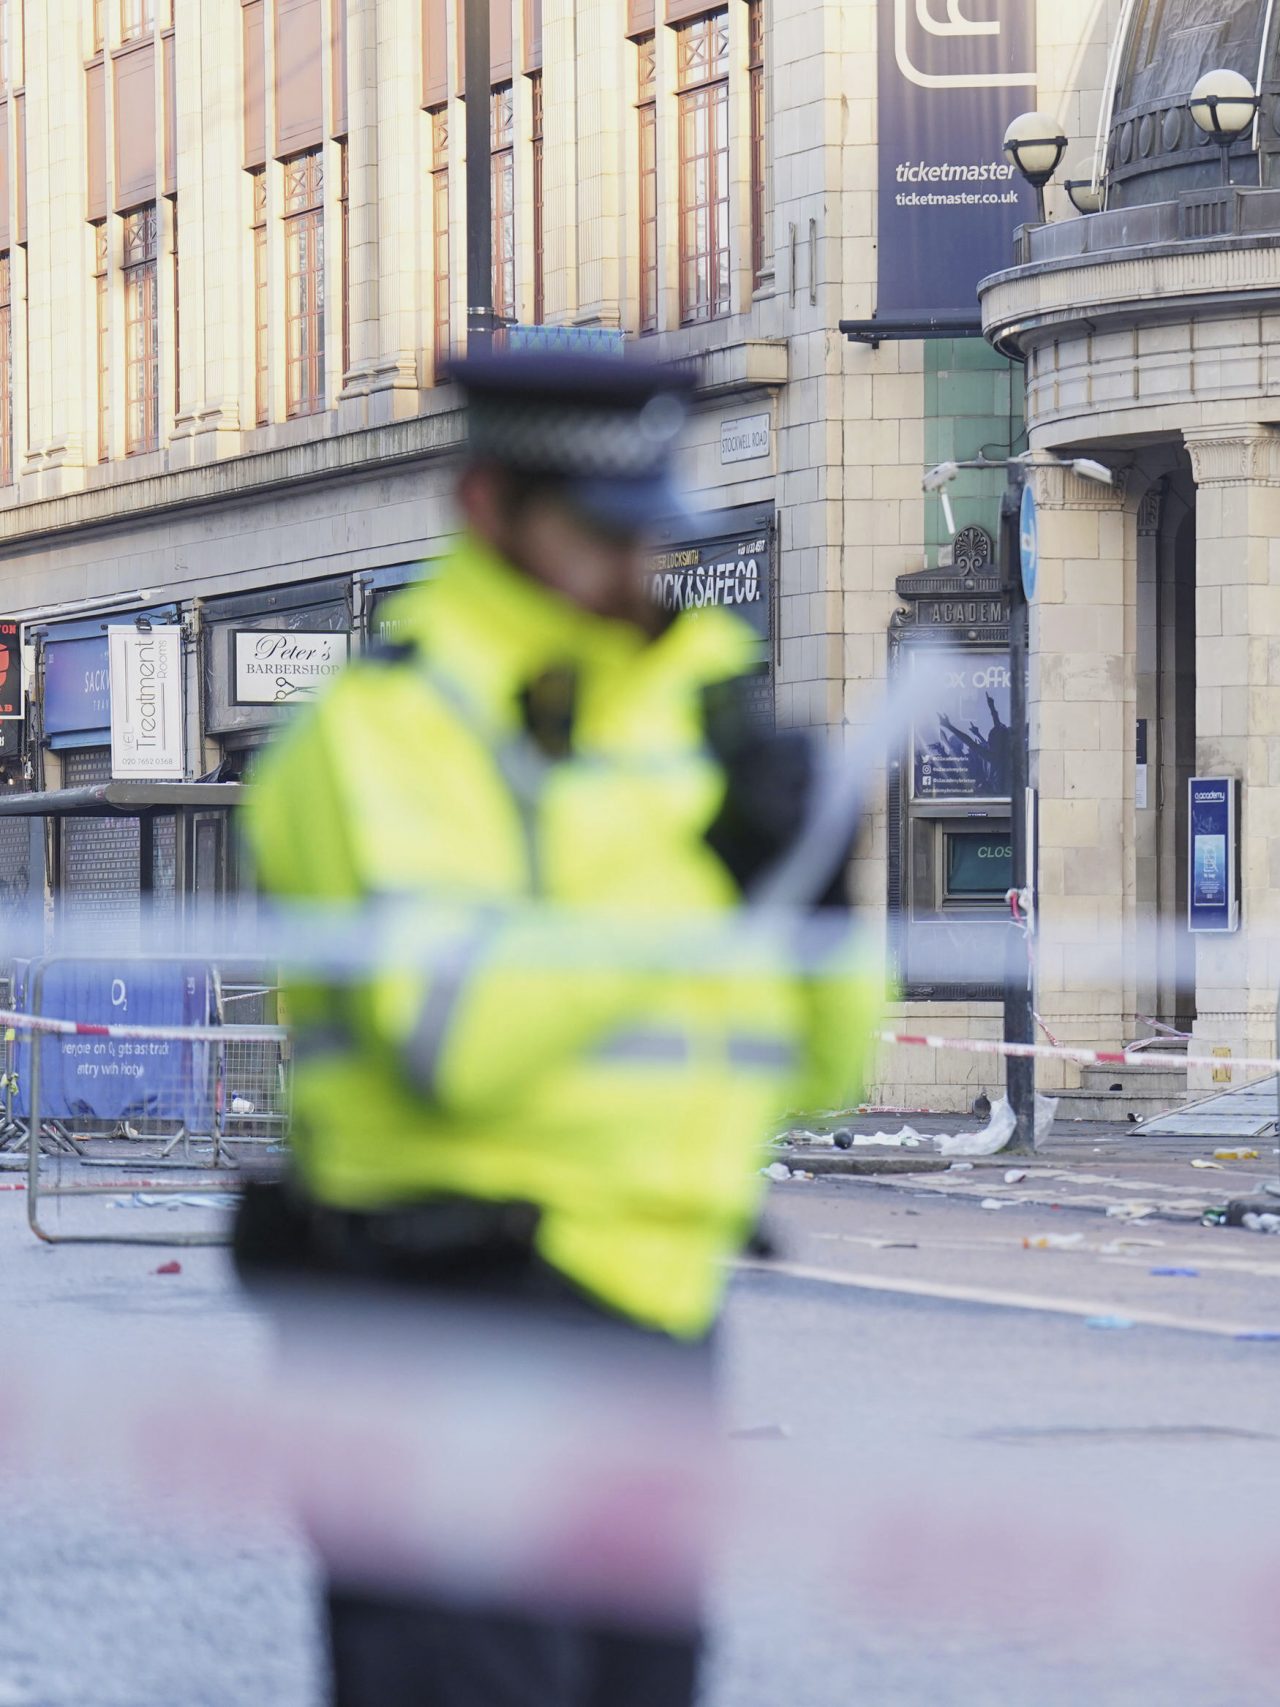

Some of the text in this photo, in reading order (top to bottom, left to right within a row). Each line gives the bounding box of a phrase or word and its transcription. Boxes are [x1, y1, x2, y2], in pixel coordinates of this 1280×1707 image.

[896, 161, 1016, 183] ticketmaster
[895, 190, 1019, 206] ticketmaster.co.uk
[721, 430, 768, 454] STOCKWELL ROAD
[254, 633, 331, 662] Peter's
[156, 640, 169, 679] Rooms
[246, 662, 341, 676] BARBERSHOP
[134, 640, 157, 752] Treatment
[122, 758, 137, 766] 020
[155, 757, 173, 766] 0368
